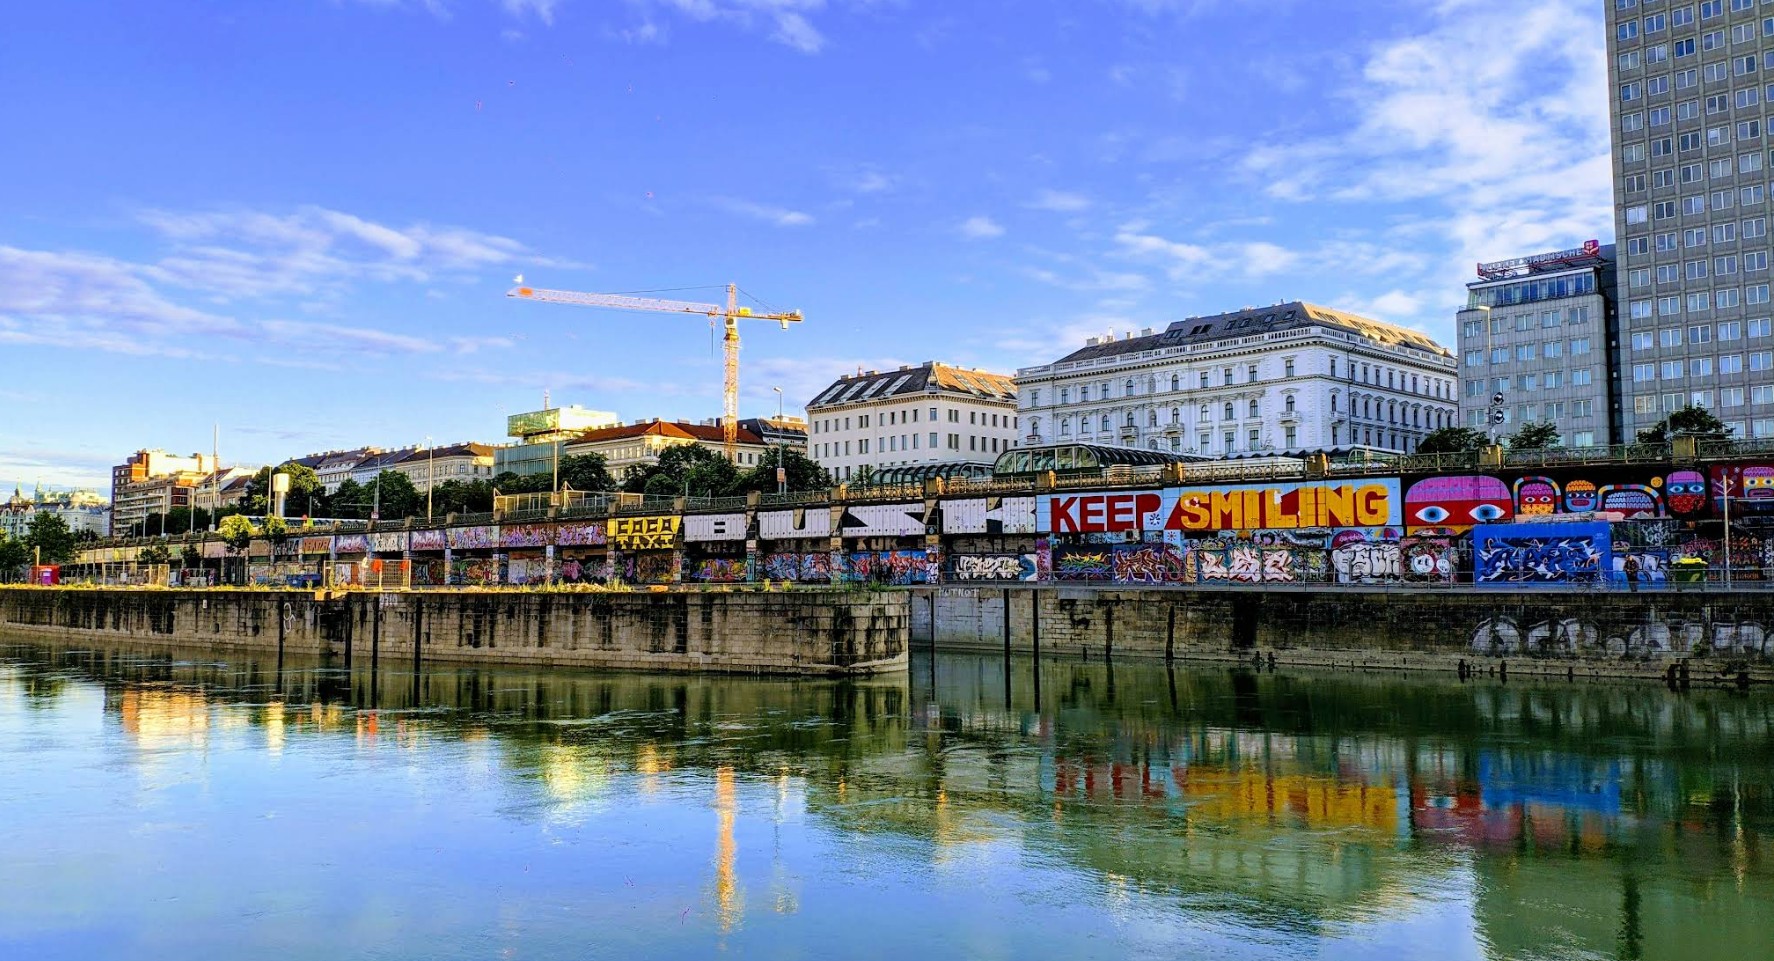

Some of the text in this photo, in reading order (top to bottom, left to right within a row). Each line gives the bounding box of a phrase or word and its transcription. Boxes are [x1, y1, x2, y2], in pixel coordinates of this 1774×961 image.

[1050, 484, 1389, 532] KEEP SMILING
[617, 517, 674, 535] COCO
[616, 535, 674, 549] TAXI
